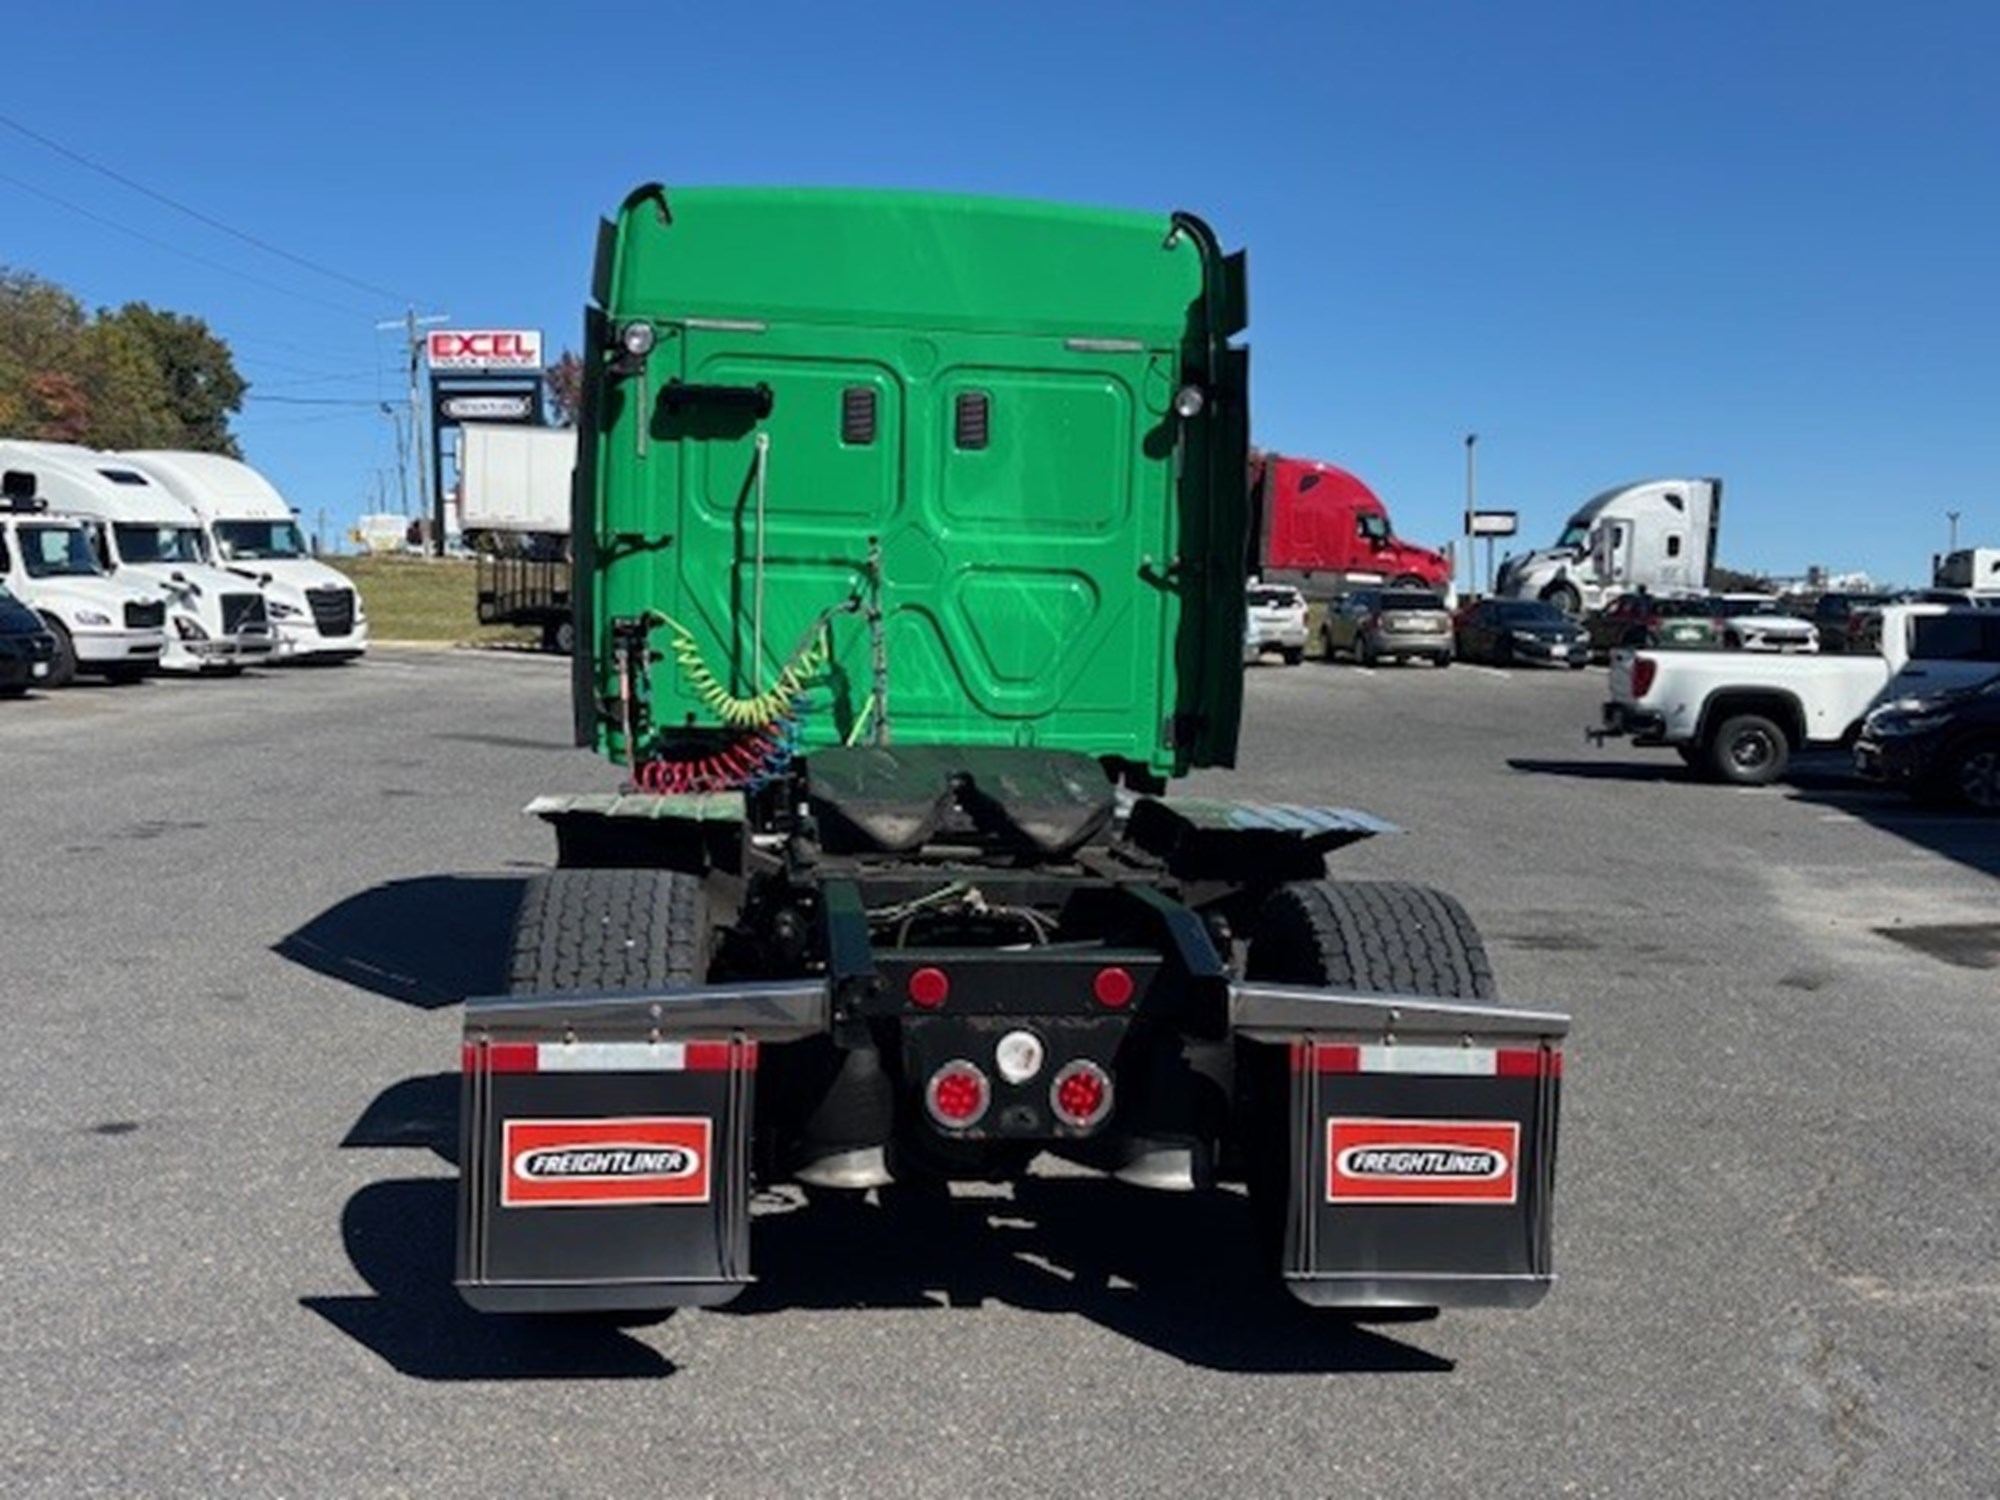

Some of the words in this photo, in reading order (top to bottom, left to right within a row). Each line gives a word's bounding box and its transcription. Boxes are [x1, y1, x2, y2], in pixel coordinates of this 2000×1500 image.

[431, 333, 536, 357] EXCEL
[531, 1151, 683, 1174] FREIGHTLINER
[1352, 1152, 1492, 1173] FREIGHTLINER
